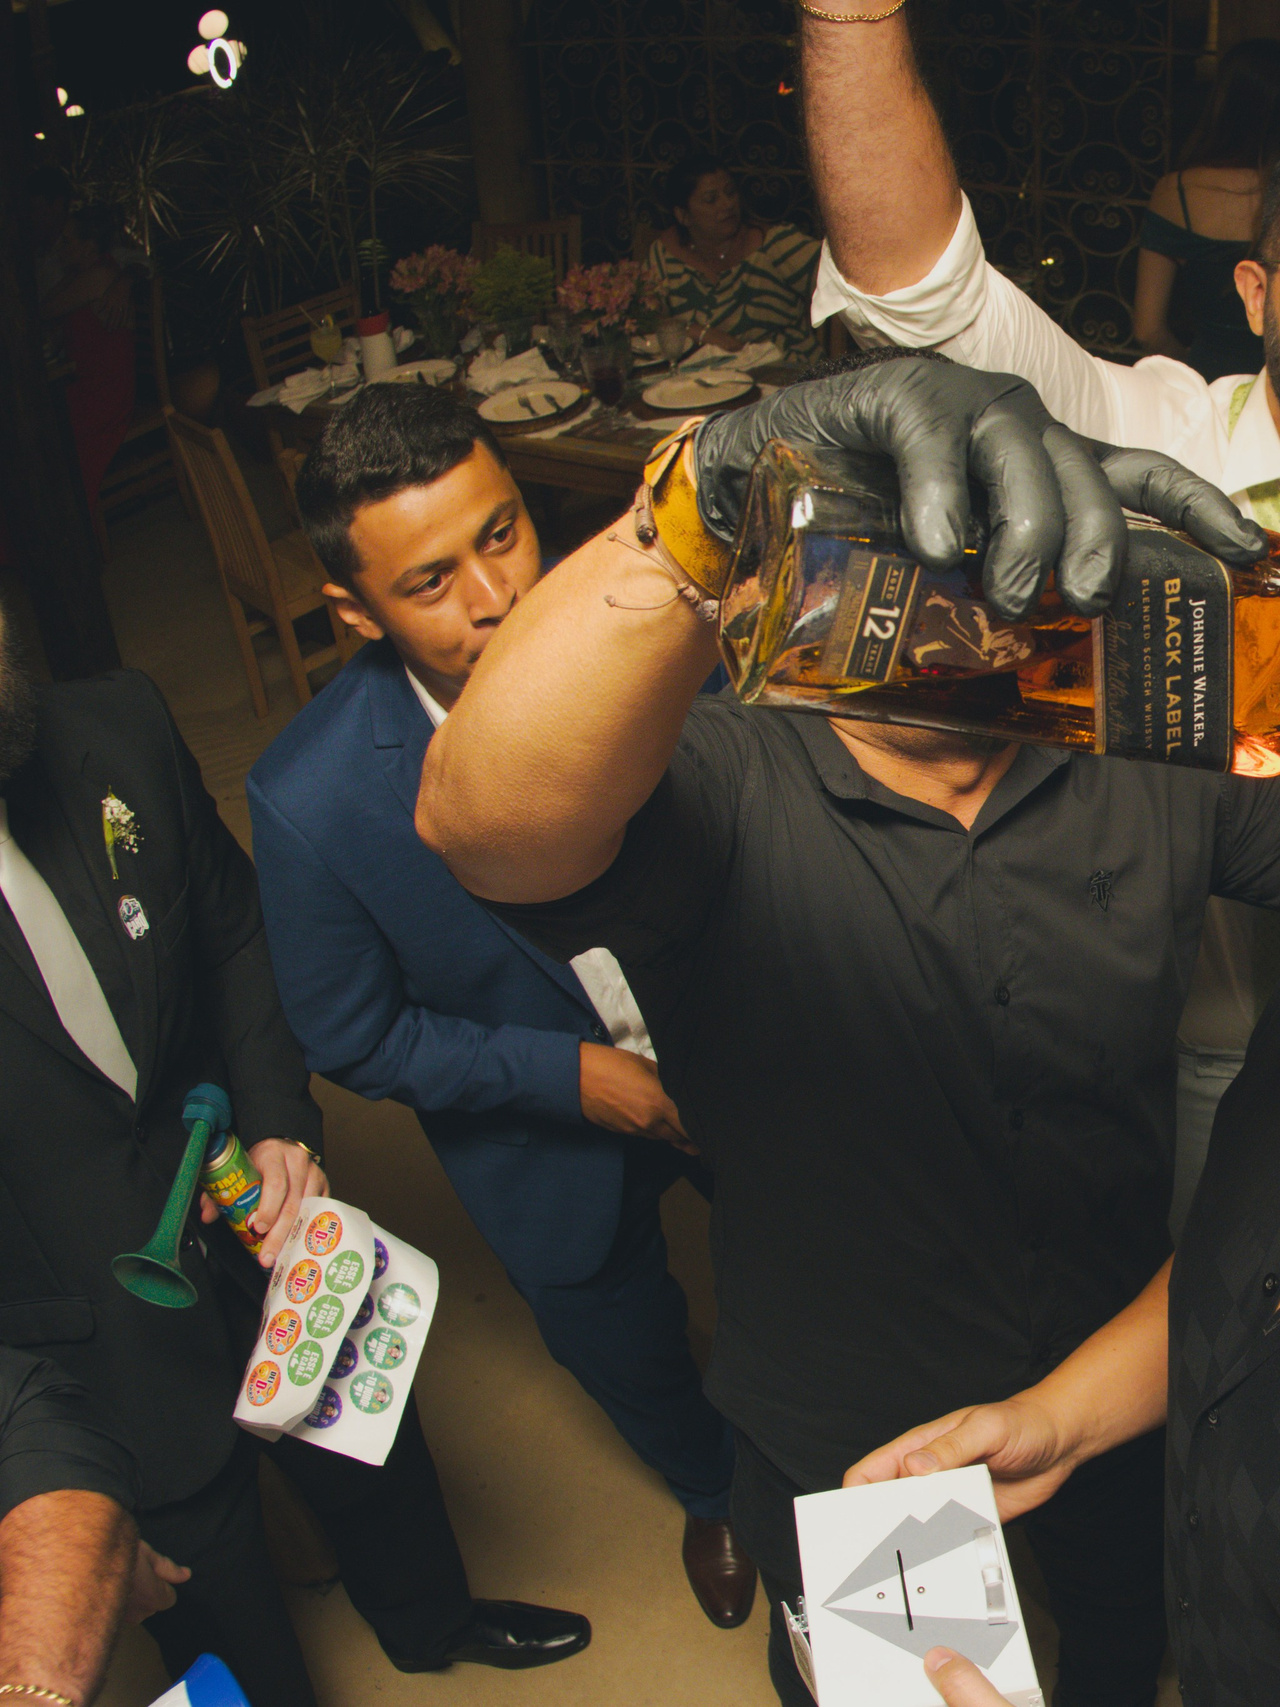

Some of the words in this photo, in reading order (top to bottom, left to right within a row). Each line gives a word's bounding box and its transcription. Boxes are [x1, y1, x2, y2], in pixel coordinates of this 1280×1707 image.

[886, 570, 899, 599] AGED
[1141, 579, 1150, 640] BLENDED
[862, 605, 900, 640] 12
[1164, 578, 1182, 667] BLACK
[1189, 600, 1206, 673] JOHNNIE
[865, 644, 879, 673] YEARS
[1143, 647, 1151, 696] SCOTCH
[1144, 702, 1152, 749] WHISKY
[328, 1221, 338, 1234] DEI
[307, 1268, 317, 1281] DEI
[334, 1265, 348, 1284] CARA
[345, 1261, 360, 1282] ESSE
[288, 1319, 297, 1332] DEI
[313, 1310, 328, 1329] CARA
[324, 1306, 340, 1326] ESSE
[380, 1332, 391, 1342] TO
[295, 1356, 308, 1376] CARA
[306, 1352, 320, 1372] ESSE
[268, 1371, 277, 1384] DEI
[366, 1376, 377, 1386] TO
